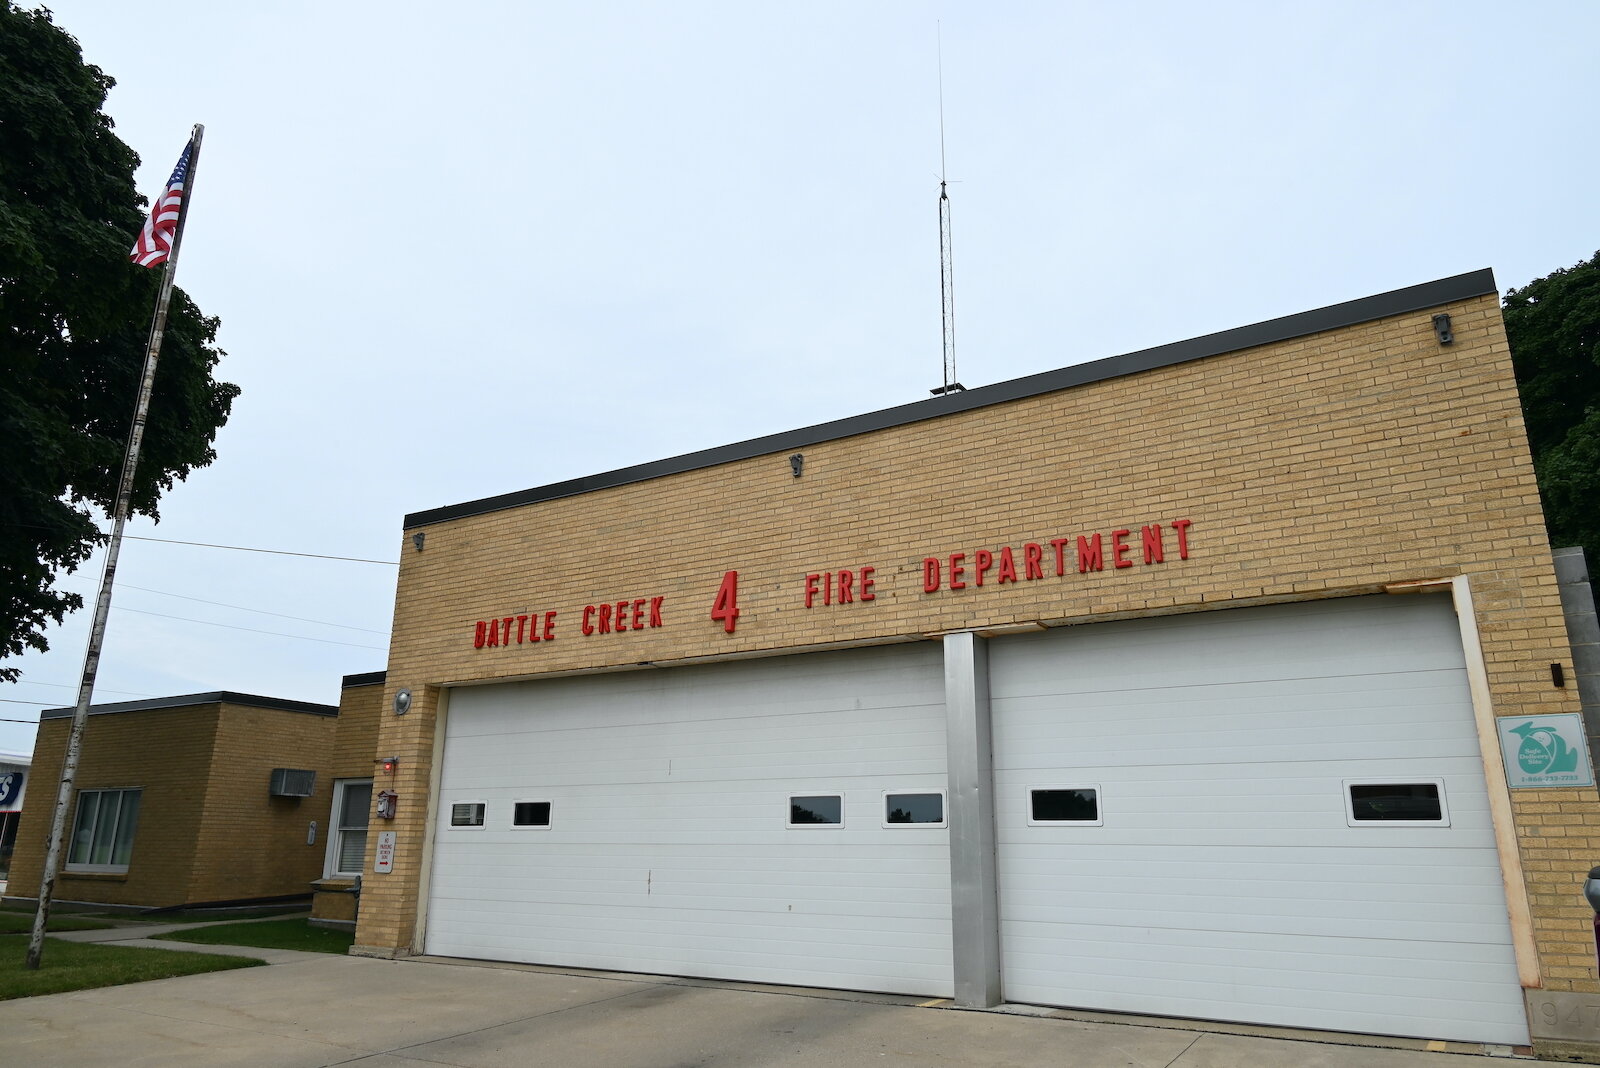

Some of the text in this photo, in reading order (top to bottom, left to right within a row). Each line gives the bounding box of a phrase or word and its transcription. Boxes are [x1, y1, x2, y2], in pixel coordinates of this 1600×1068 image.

[473, 520, 1192, 648] BATTLE CREEK 4 FIRE DEPARTMENT
